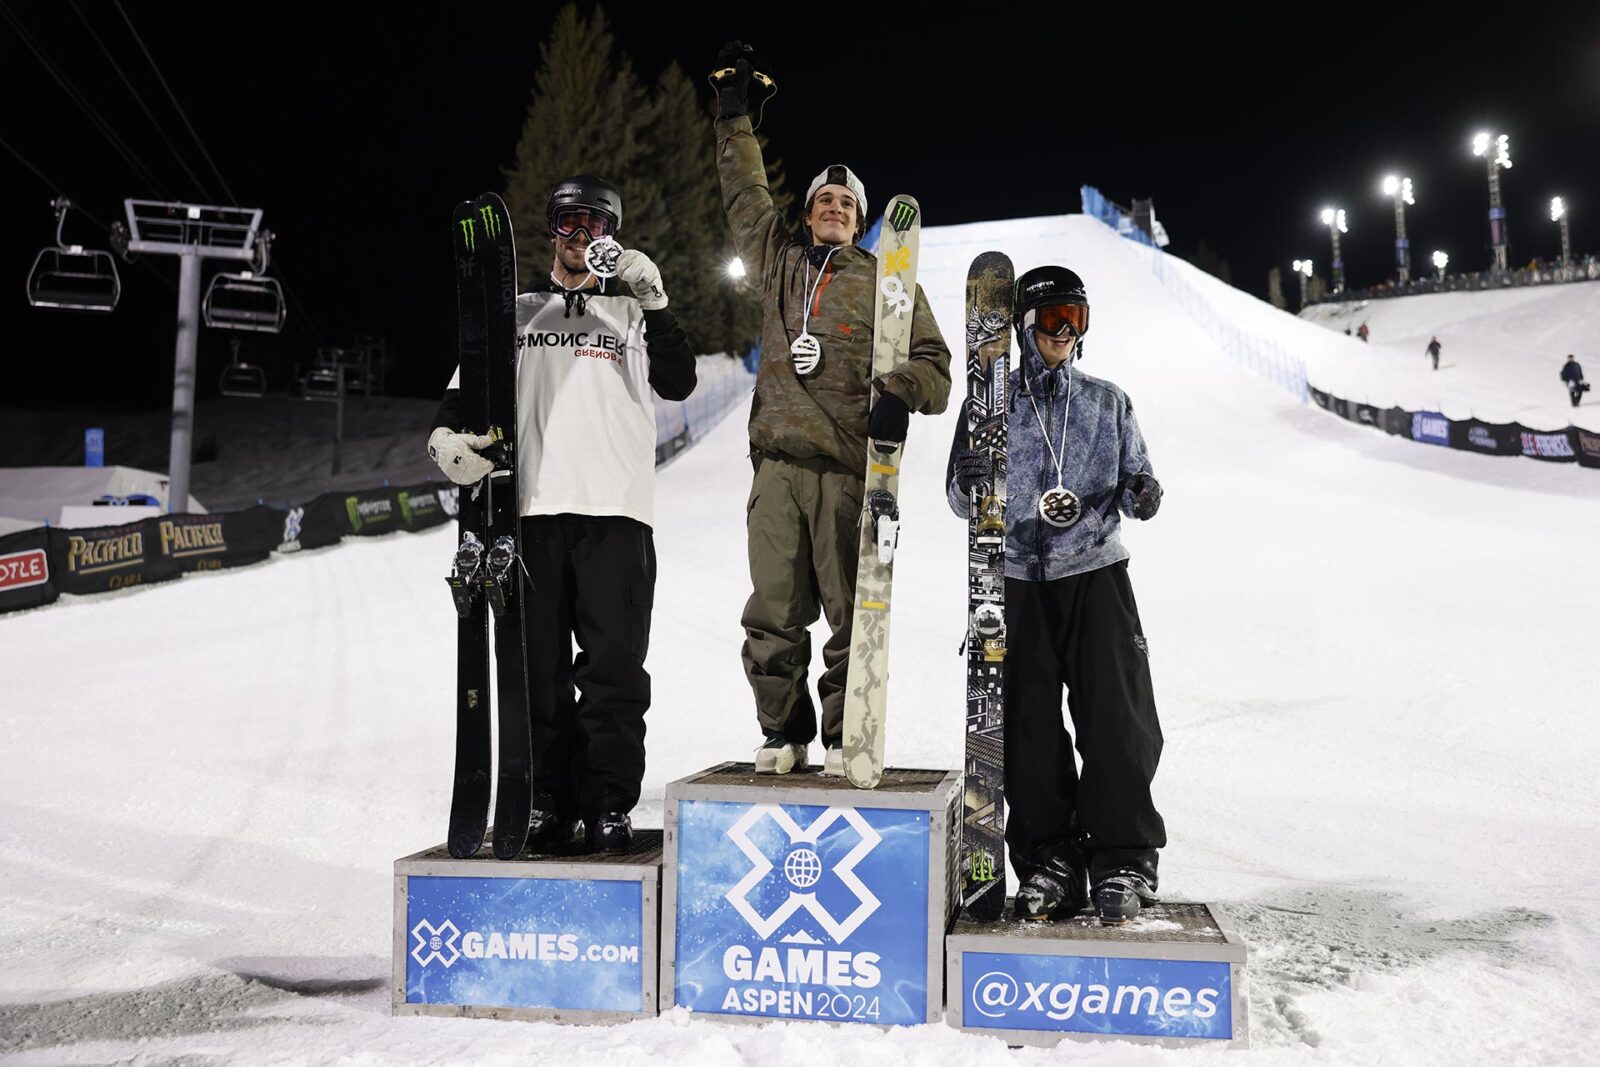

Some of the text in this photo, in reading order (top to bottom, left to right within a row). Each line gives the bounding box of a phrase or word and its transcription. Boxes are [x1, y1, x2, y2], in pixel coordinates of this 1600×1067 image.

[499, 244, 514, 314] FACTION
[884, 246, 911, 277] K2
[574, 349, 624, 368] GRENOBE
[68, 532, 143, 572] PACIFICO
[159, 521, 225, 556] PACIFICO
[723, 944, 882, 989] GAMES
[721, 987, 880, 1019] ASPEN 2024
[971, 971, 1220, 1021] @xgames
